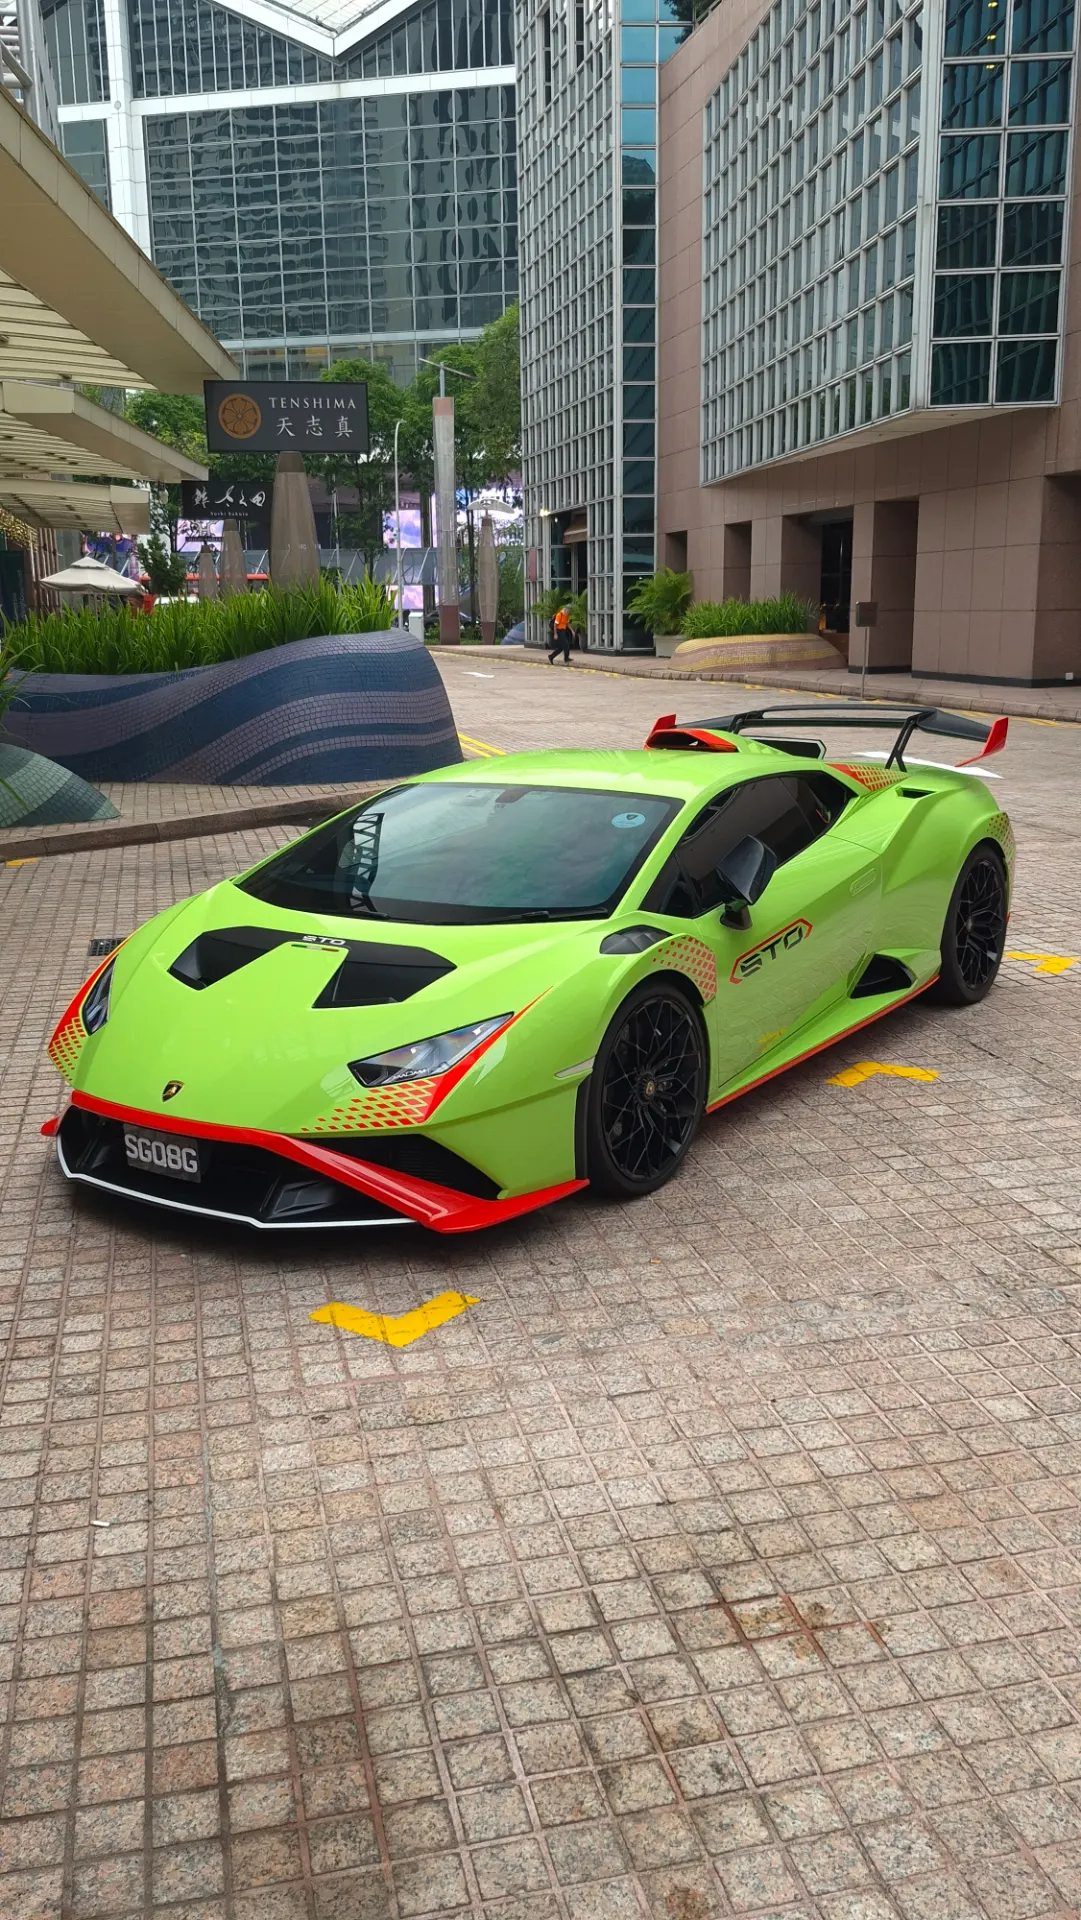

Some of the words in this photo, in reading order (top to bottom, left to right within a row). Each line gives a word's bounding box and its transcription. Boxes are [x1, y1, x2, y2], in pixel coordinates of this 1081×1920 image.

[268, 397, 357, 409] TENSHIMA
[276, 414, 353, 438] 天志真
[302, 935, 346, 946] STO
[739, 925, 804, 978] STO
[124, 1133, 198, 1173] SGQ8G
